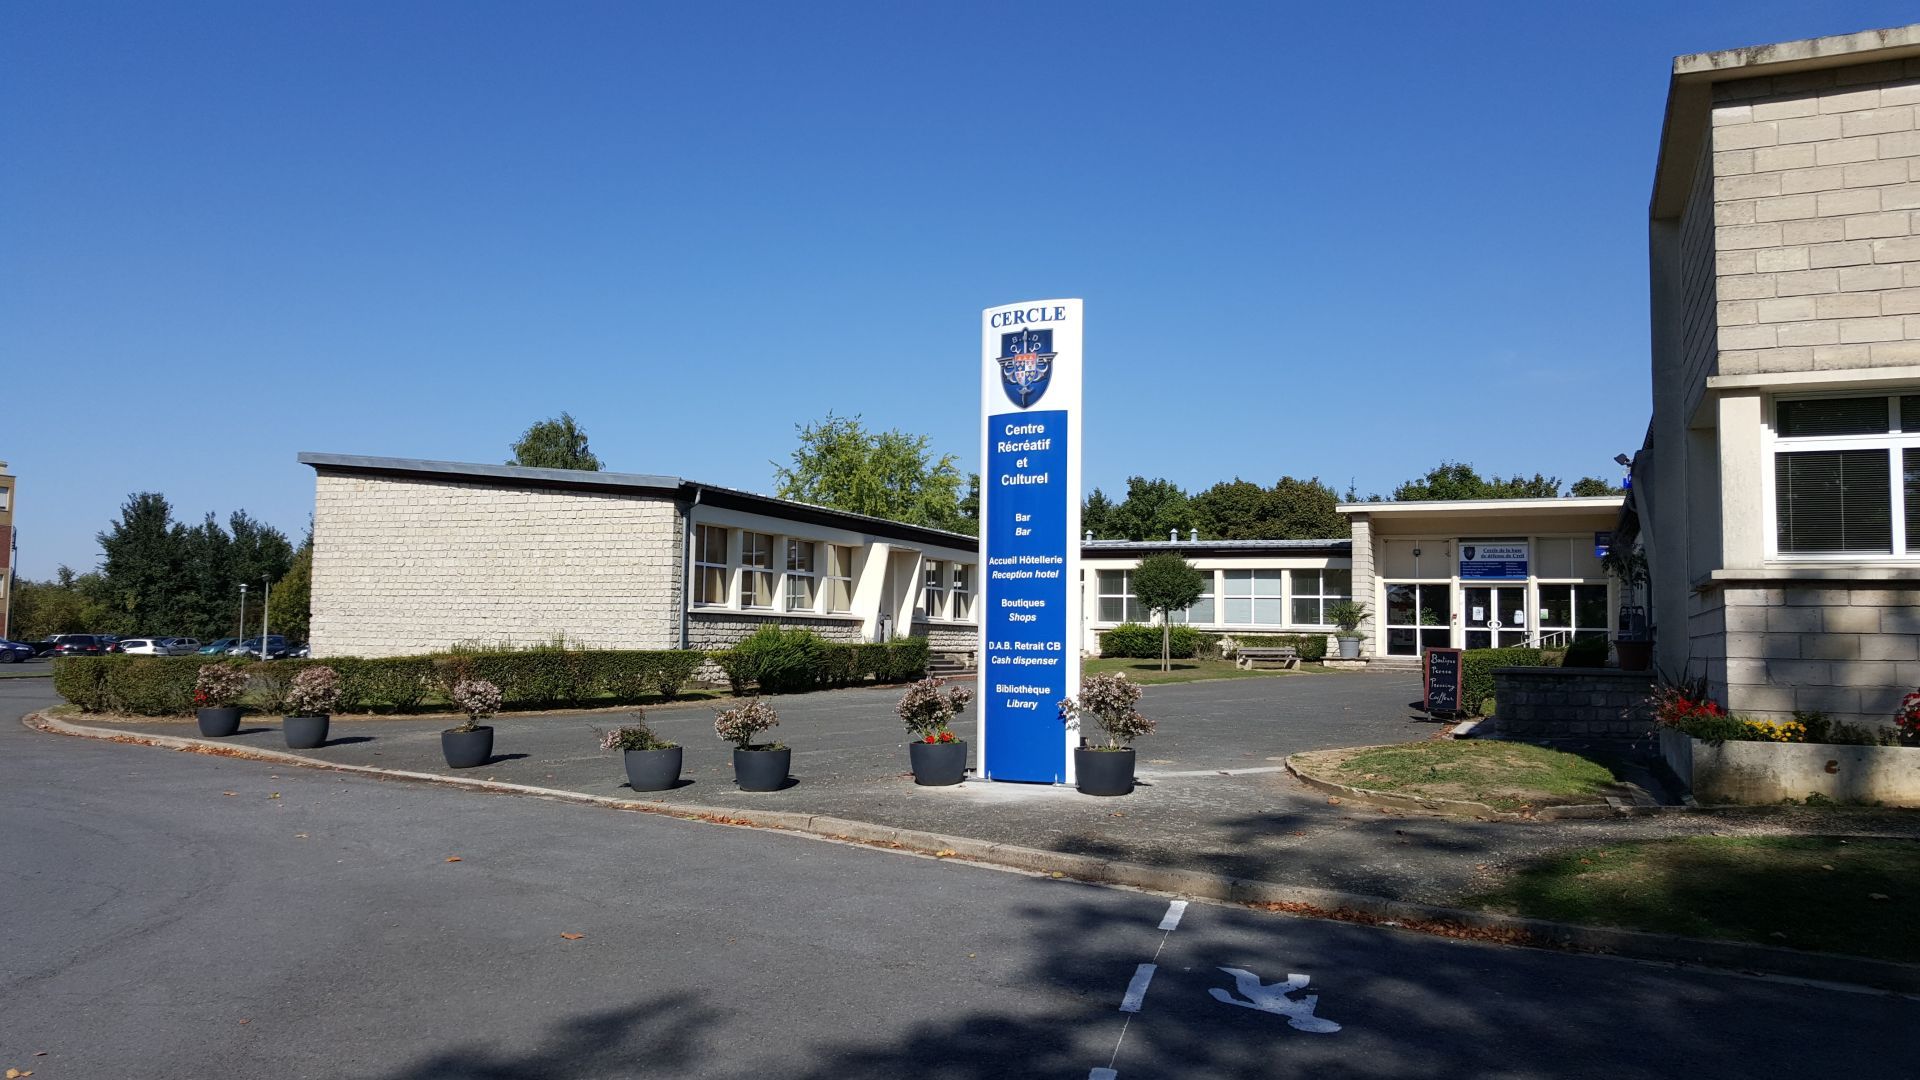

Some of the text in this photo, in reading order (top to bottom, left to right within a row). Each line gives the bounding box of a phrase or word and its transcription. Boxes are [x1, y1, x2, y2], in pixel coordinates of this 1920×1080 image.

[990, 306, 1066, 328] CERCLE
[1005, 423, 1045, 436] Centre
[997, 438, 1051, 453] Récréatif
[1016, 457, 1028, 468] et
[1001, 472, 1048, 486] Culturel
[1015, 513, 1031, 522] Bar
[1015, 527, 1032, 536] Bar
[988, 554, 1063, 565] Accueil Hôtellerie
[991, 569, 1059, 580] Reception hotel
[1001, 598, 1045, 608] Boutiques
[1008, 613, 1037, 623] Shops
[988, 641, 1061, 651] D.A.B. Retrait CB
[991, 655, 1058, 667] Cash dispenser
[996, 684, 1051, 696] Bibliothèque
[1006, 699, 1038, 711] Library
